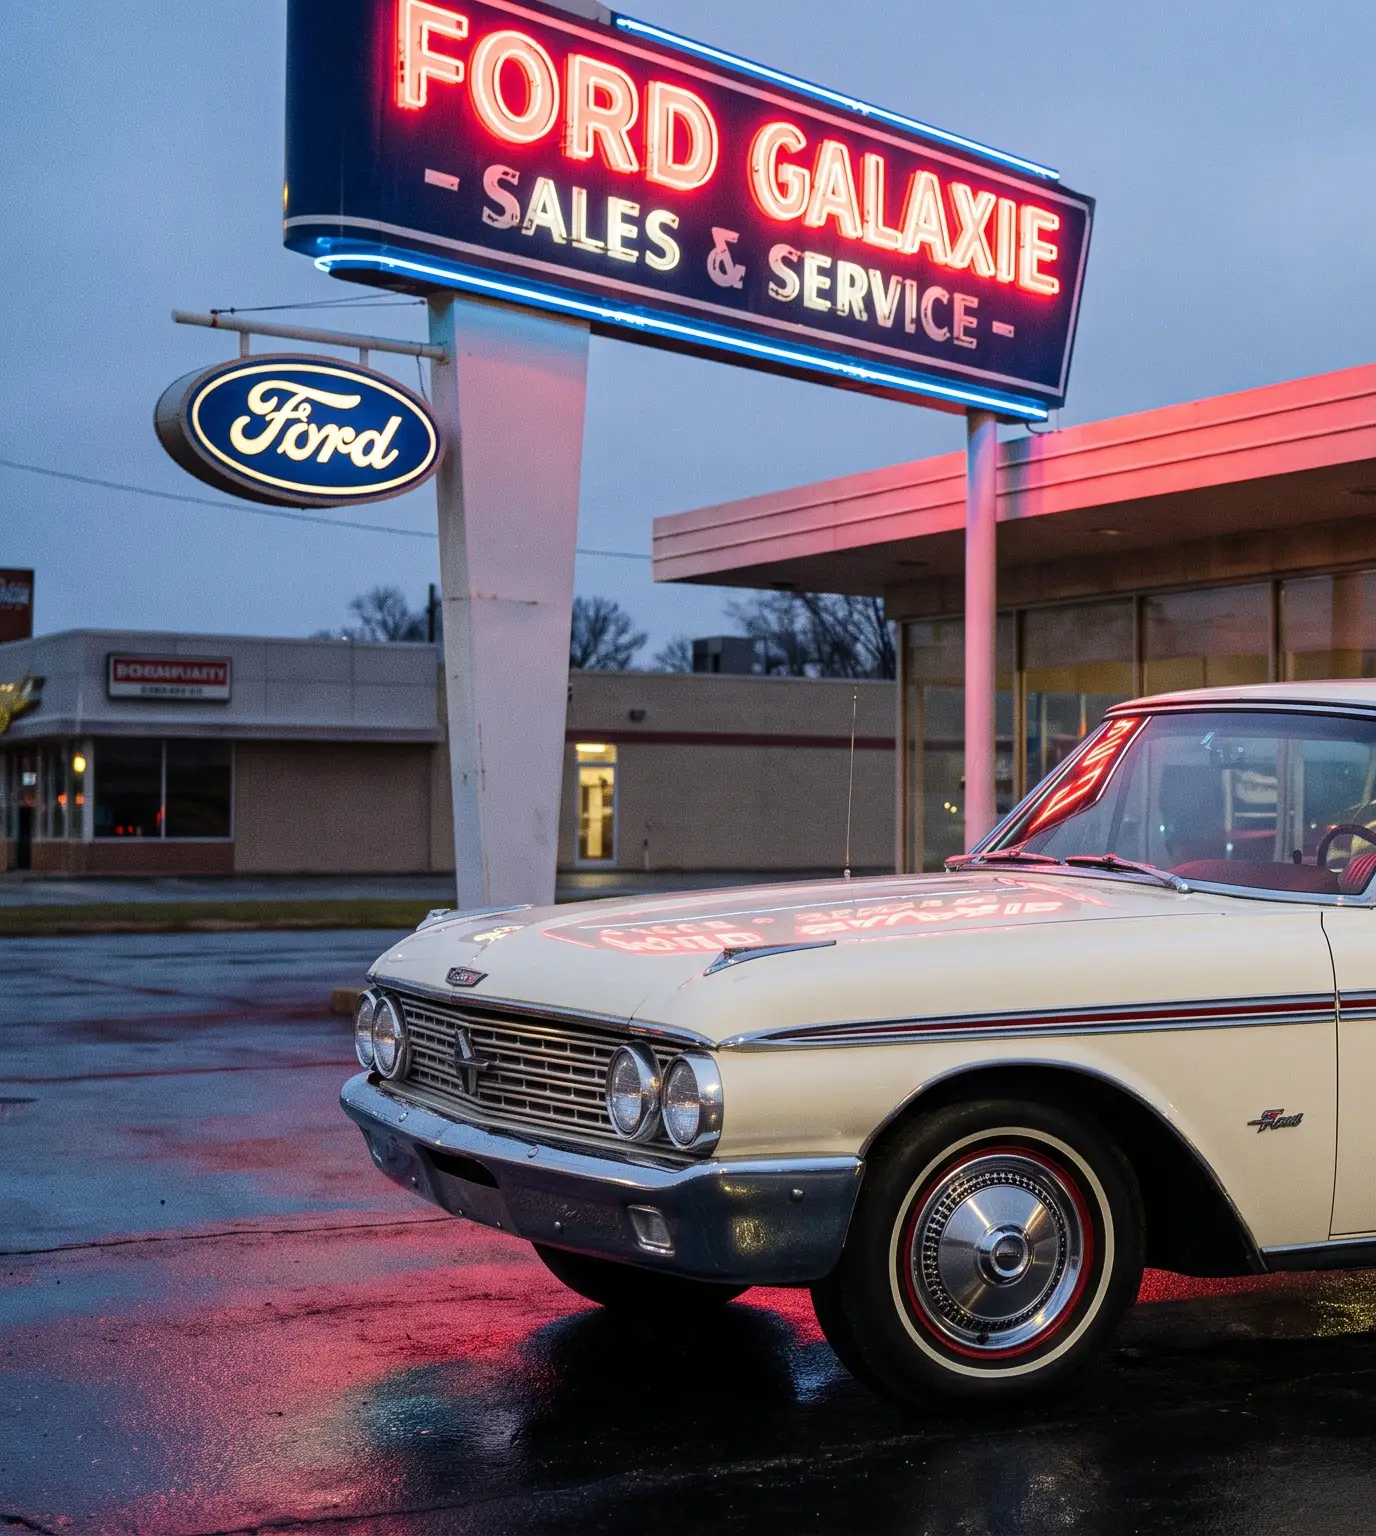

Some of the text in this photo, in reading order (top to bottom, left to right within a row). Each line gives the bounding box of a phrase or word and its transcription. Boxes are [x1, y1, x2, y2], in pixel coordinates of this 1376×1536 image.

[394, 0, 1060, 296] FORD GALAXIE
[482, 164, 680, 271] SALES
[706, 226, 747, 289] &
[768, 243, 979, 349] SERVICE
[229, 379, 402, 470] Ford
